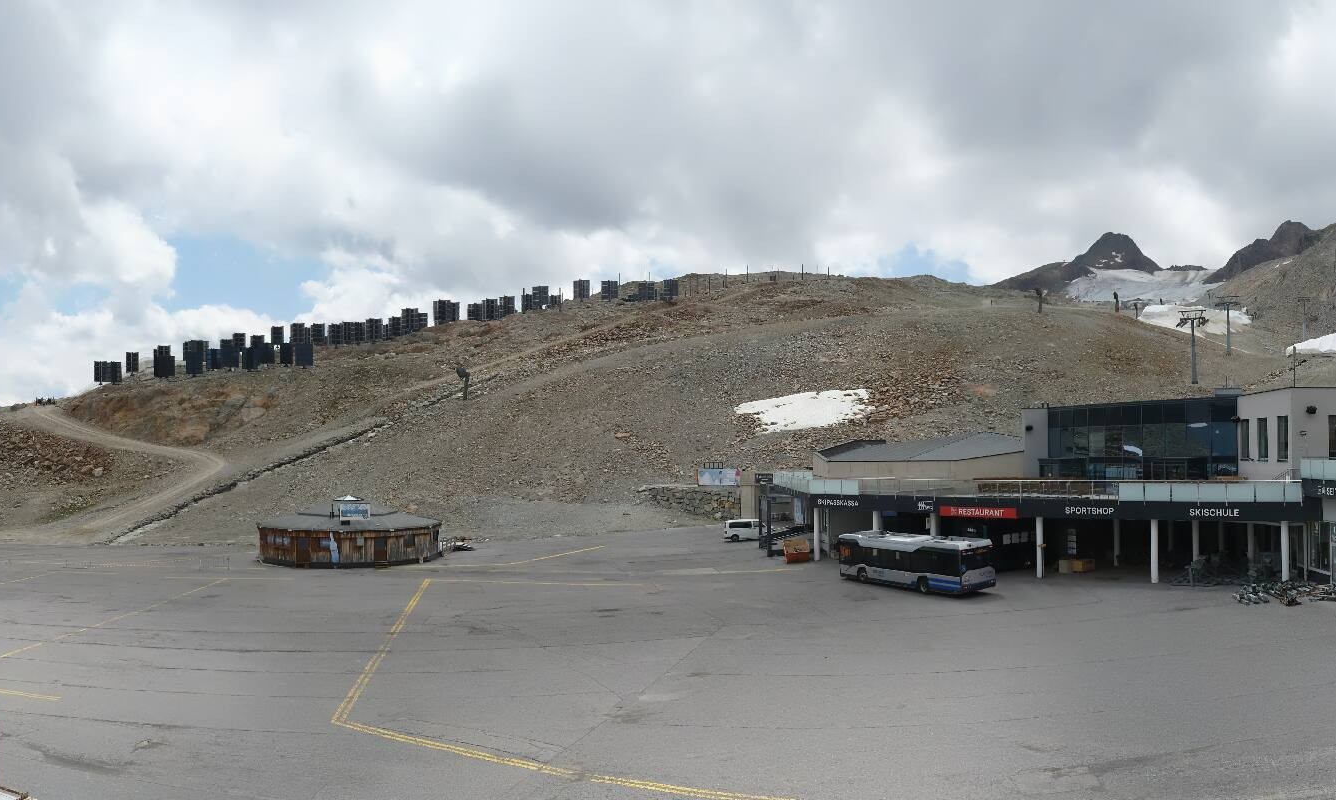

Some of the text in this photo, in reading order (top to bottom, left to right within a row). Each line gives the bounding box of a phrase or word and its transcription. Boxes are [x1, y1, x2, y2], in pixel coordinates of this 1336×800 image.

[817, 498, 859, 507] SKIPASSKASSA
[958, 508, 1004, 517] RESTAURANT
[1065, 506, 1114, 515] SPORTSHOP
[1189, 508, 1240, 517] SKISCHULE
